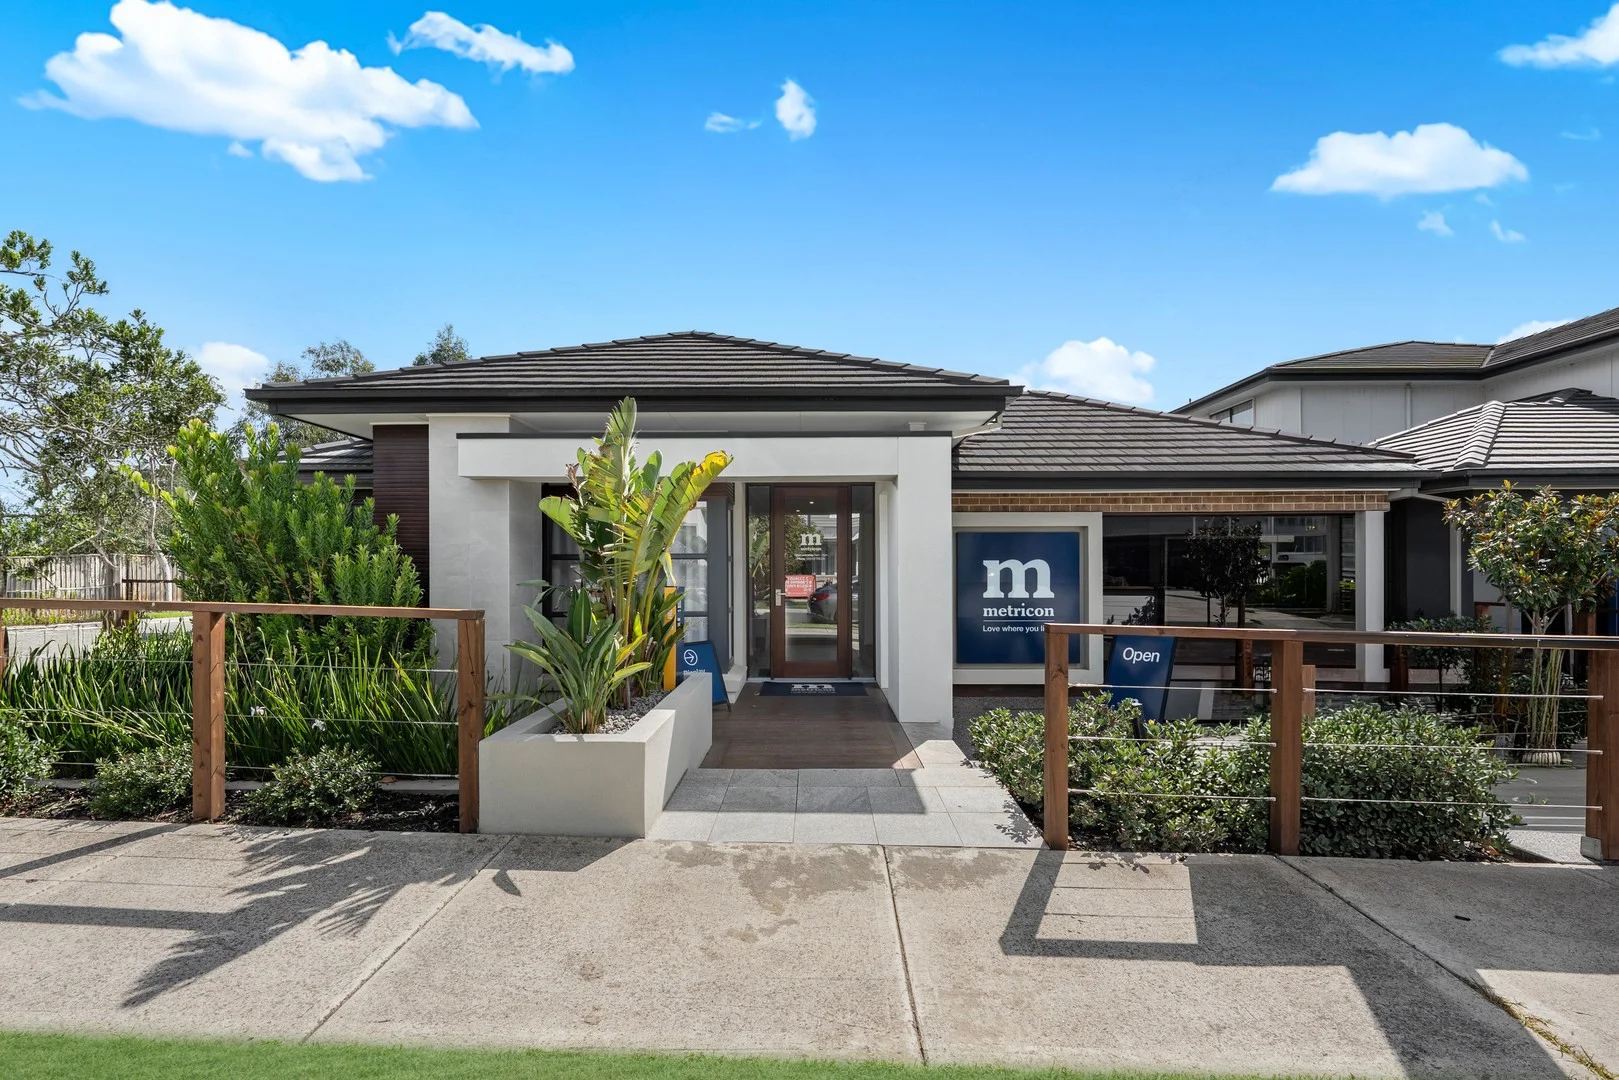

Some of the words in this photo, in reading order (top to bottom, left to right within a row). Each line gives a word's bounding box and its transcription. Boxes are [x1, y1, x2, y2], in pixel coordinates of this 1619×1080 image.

[801, 533, 822, 546] m
[982, 559, 1055, 598] m
[983, 603, 1055, 617] metricon
[1122, 647, 1160, 664] Open
